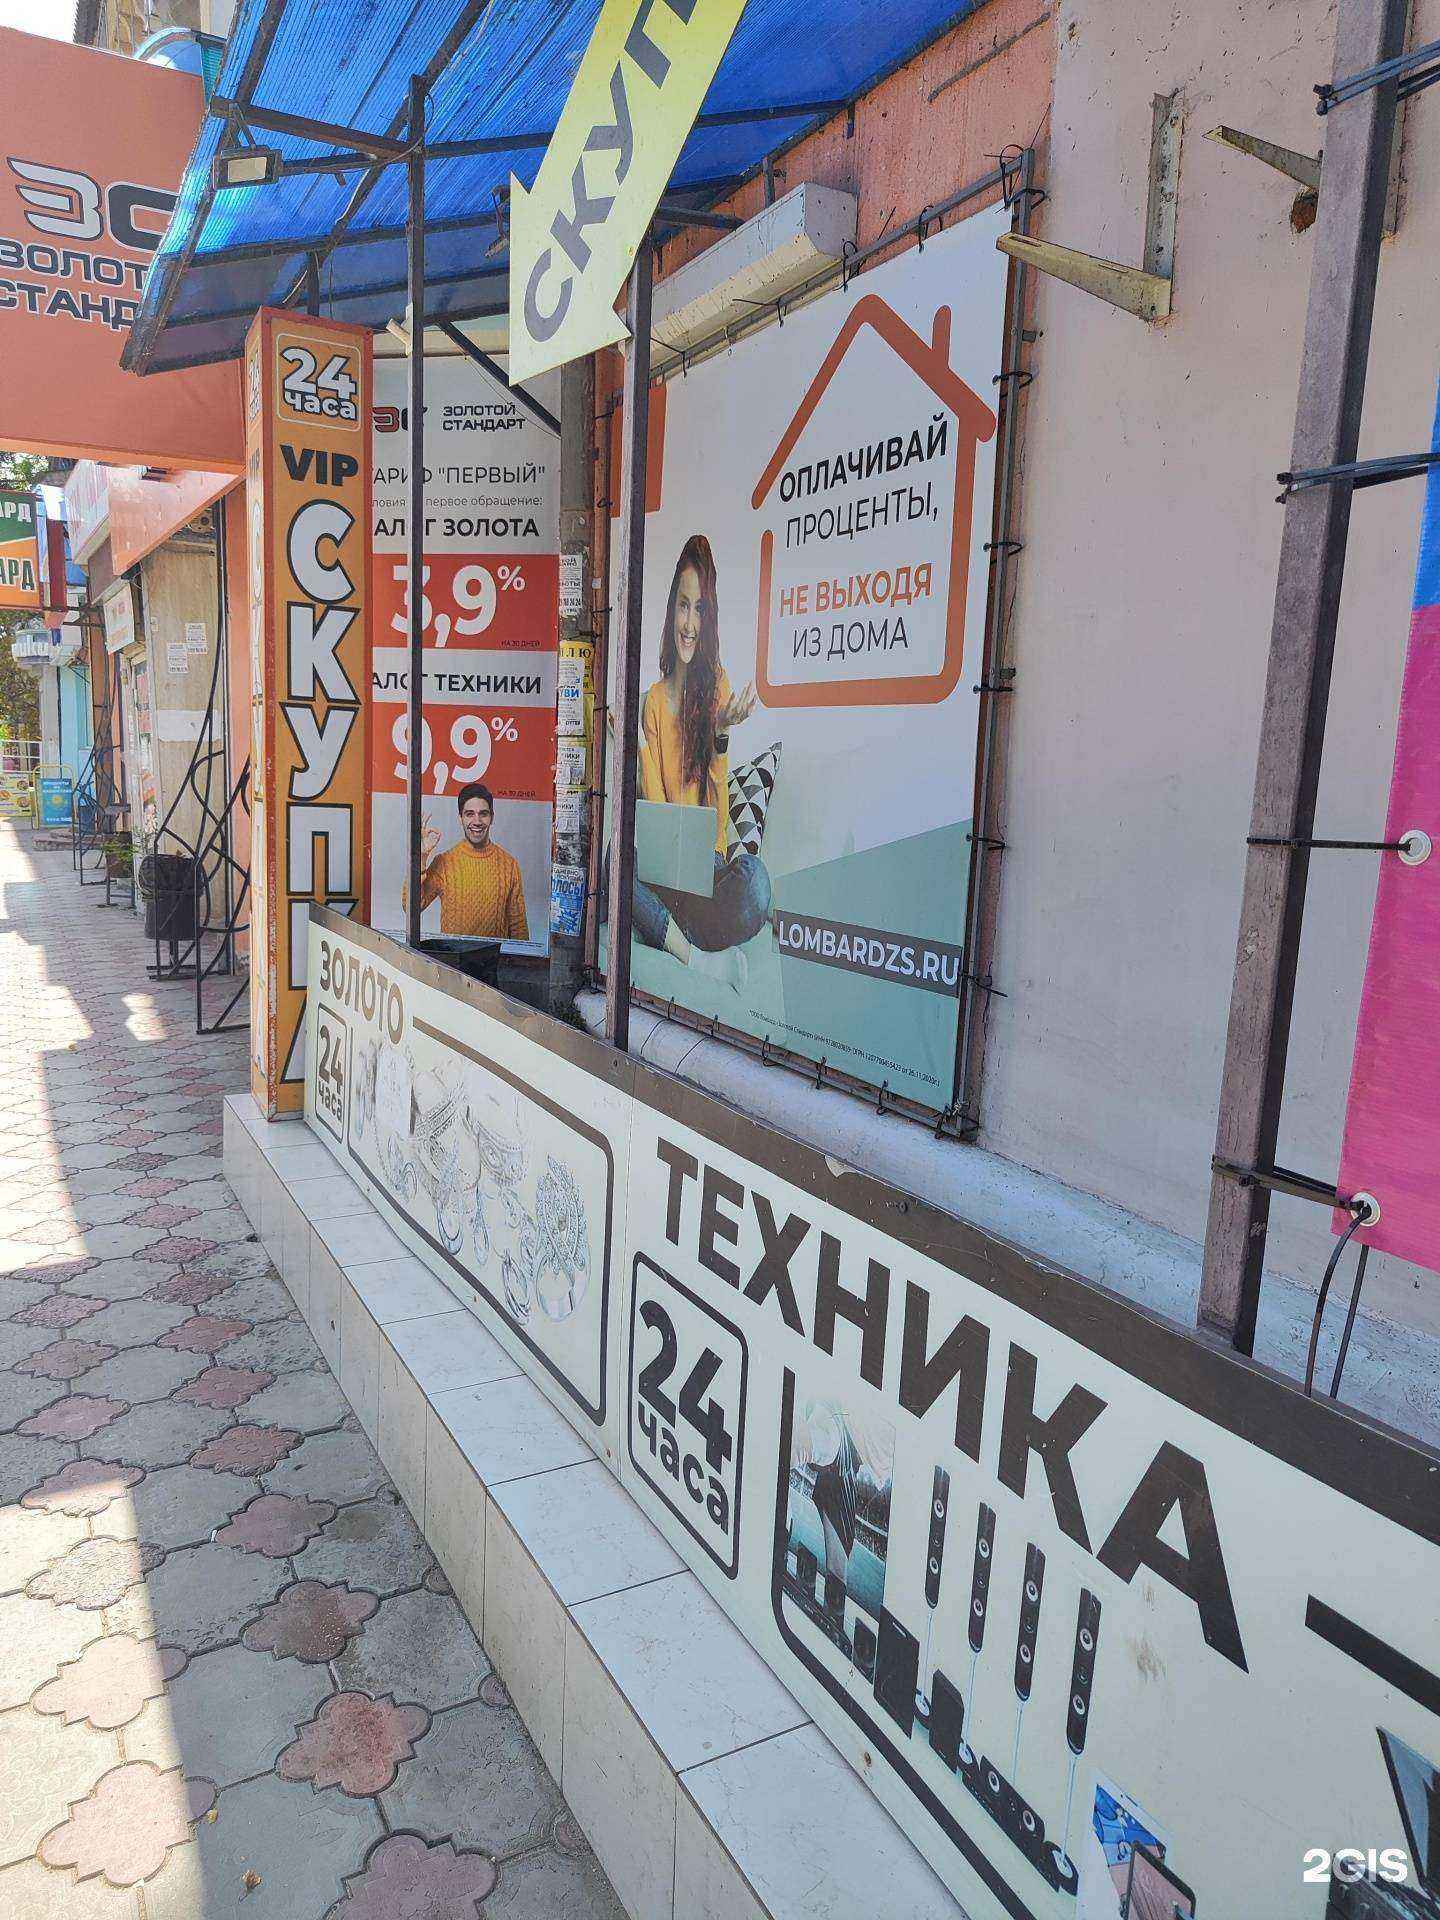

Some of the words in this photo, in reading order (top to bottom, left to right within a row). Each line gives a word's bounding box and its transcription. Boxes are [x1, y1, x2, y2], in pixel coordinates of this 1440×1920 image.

[0, 237, 149, 291] ЗОЛОТ
[0, 279, 140, 331] СТАНД
[279, 346, 357, 400] 24
[284, 391, 358, 421] часа
[443, 402, 516, 417] ЗОЛОТОЙ
[443, 418, 526, 432] СТАНДАРТ
[279, 444, 359, 486] VIP
[438, 462, 546, 484] "ПЕРВЫЙ"
[780, 412, 948, 502] ОПЛАЧИВАЙ
[426, 497, 468, 508] первое
[471, 494, 543, 510] обращение:
[443, 518, 540, 537] ЗОЛОТА
[786, 482, 938, 548] ПРОЦЕНТЫ,
[779, 585, 809, 617] НЕ
[816, 562, 933, 612] ВЫХОДЯ
[793, 626, 821, 658] ИЗ
[827, 616, 908, 661] ДОМА
[434, 673, 541, 694] ТЕХНИКИ
[779, 921, 961, 985] LOMBARDZS.RU
[320, 940, 404, 1045] ЗОЛОТО
[318, 1024, 344, 1095] 24
[318, 1080, 344, 1122] часа
[638, 1299, 733, 1475] 24
[657, 1136, 1250, 1674] ТЕХНИКА
[637, 1400, 729, 1536] часа
